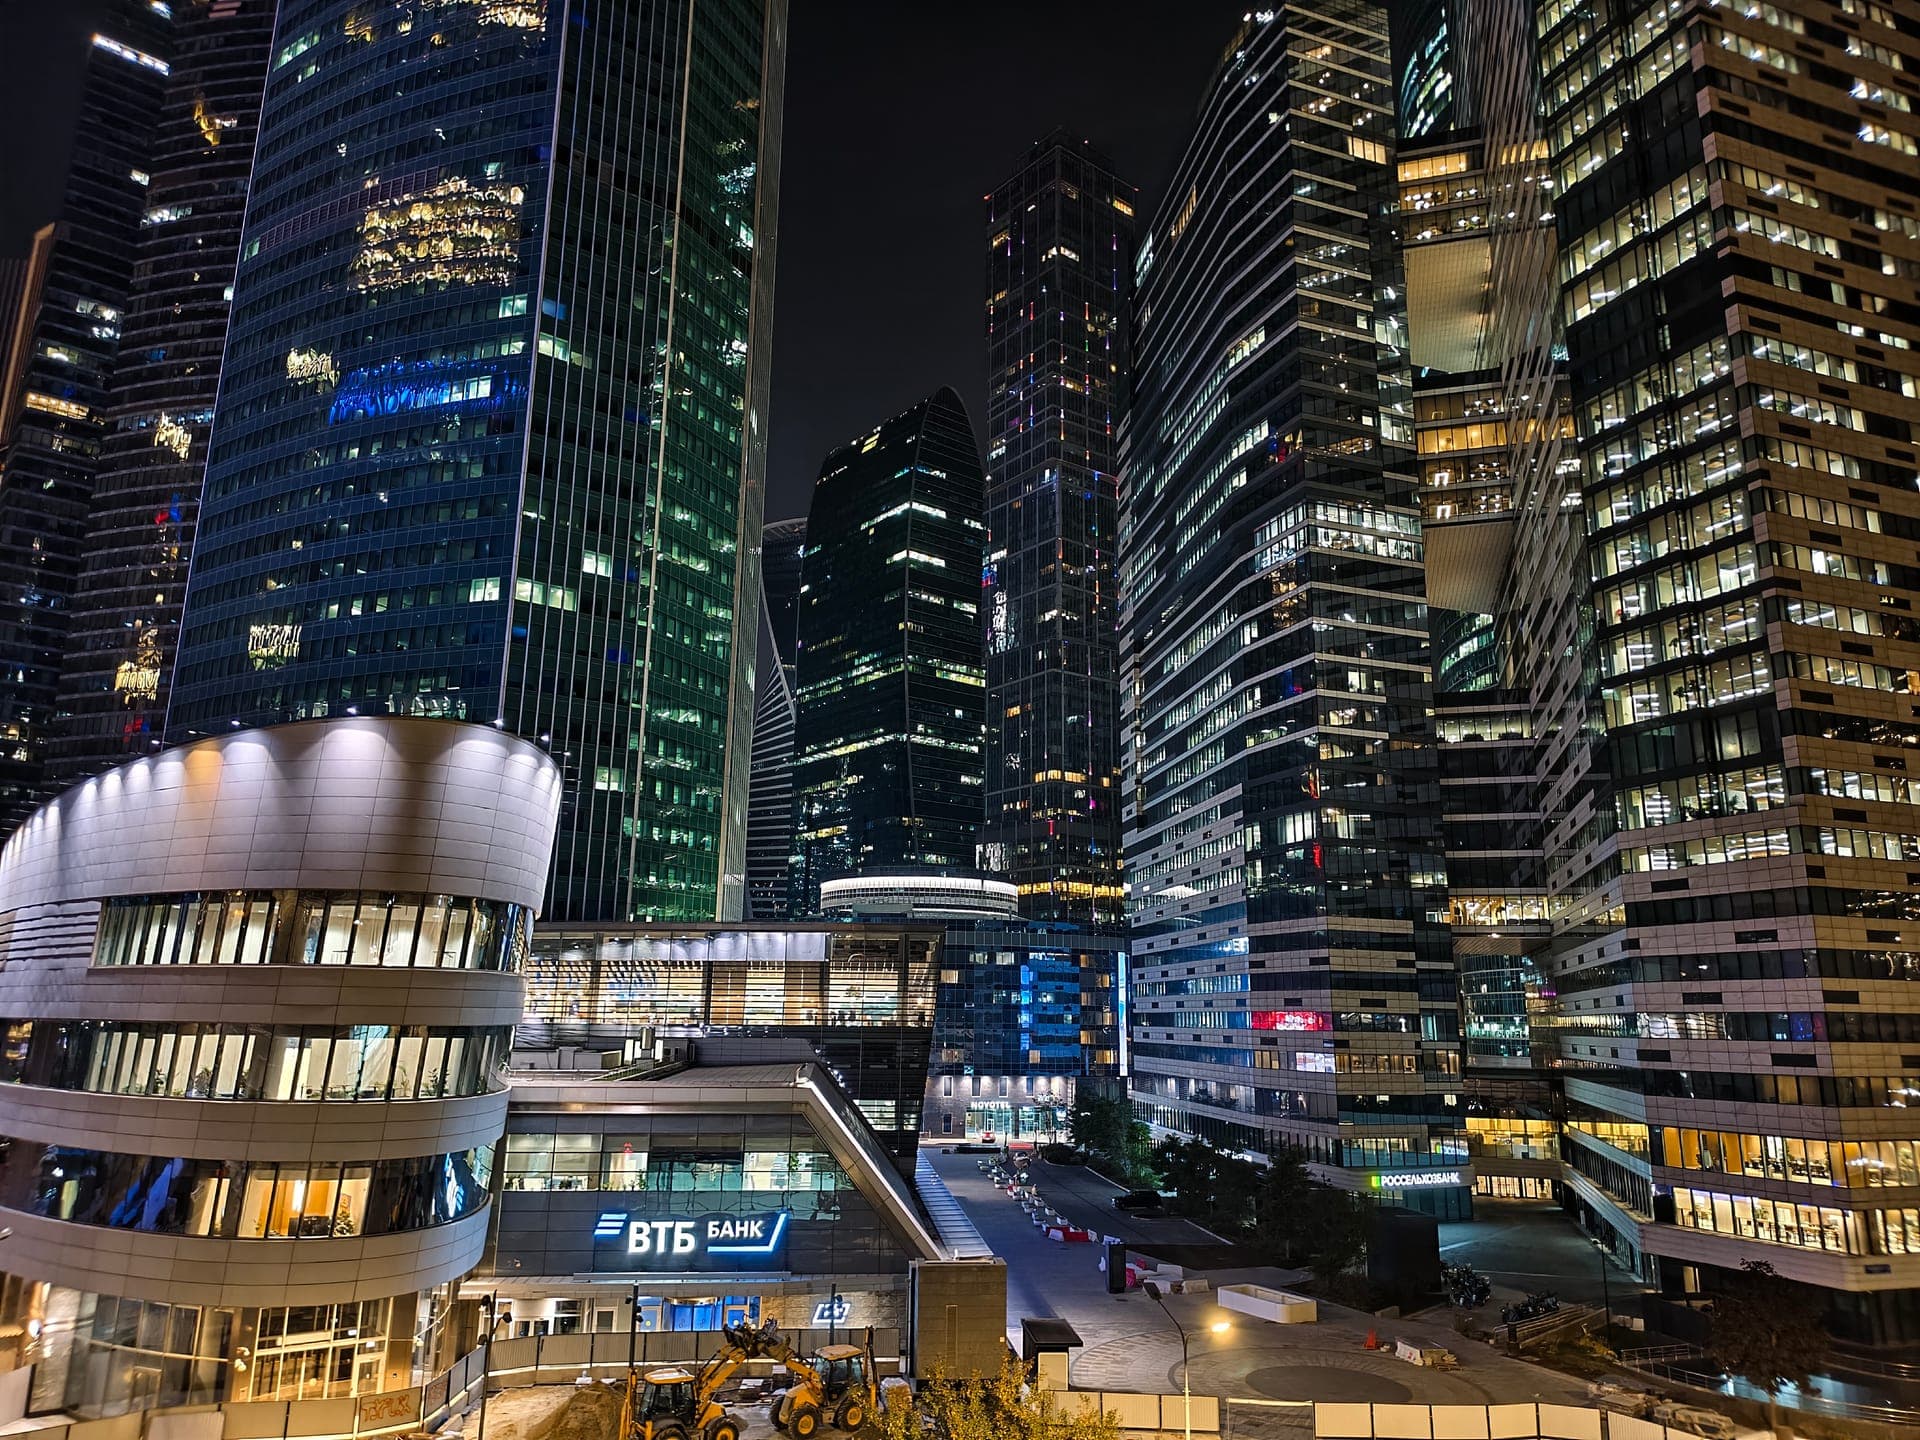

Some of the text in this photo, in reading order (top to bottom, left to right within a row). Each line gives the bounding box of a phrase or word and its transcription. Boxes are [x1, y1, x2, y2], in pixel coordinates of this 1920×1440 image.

[970, 1101, 1010, 1109] NOVOTEL
[1381, 1172, 1460, 1187] РОССЕЛЬХОЗБАНК
[627, 1220, 763, 1254] ВТБ БАНК
